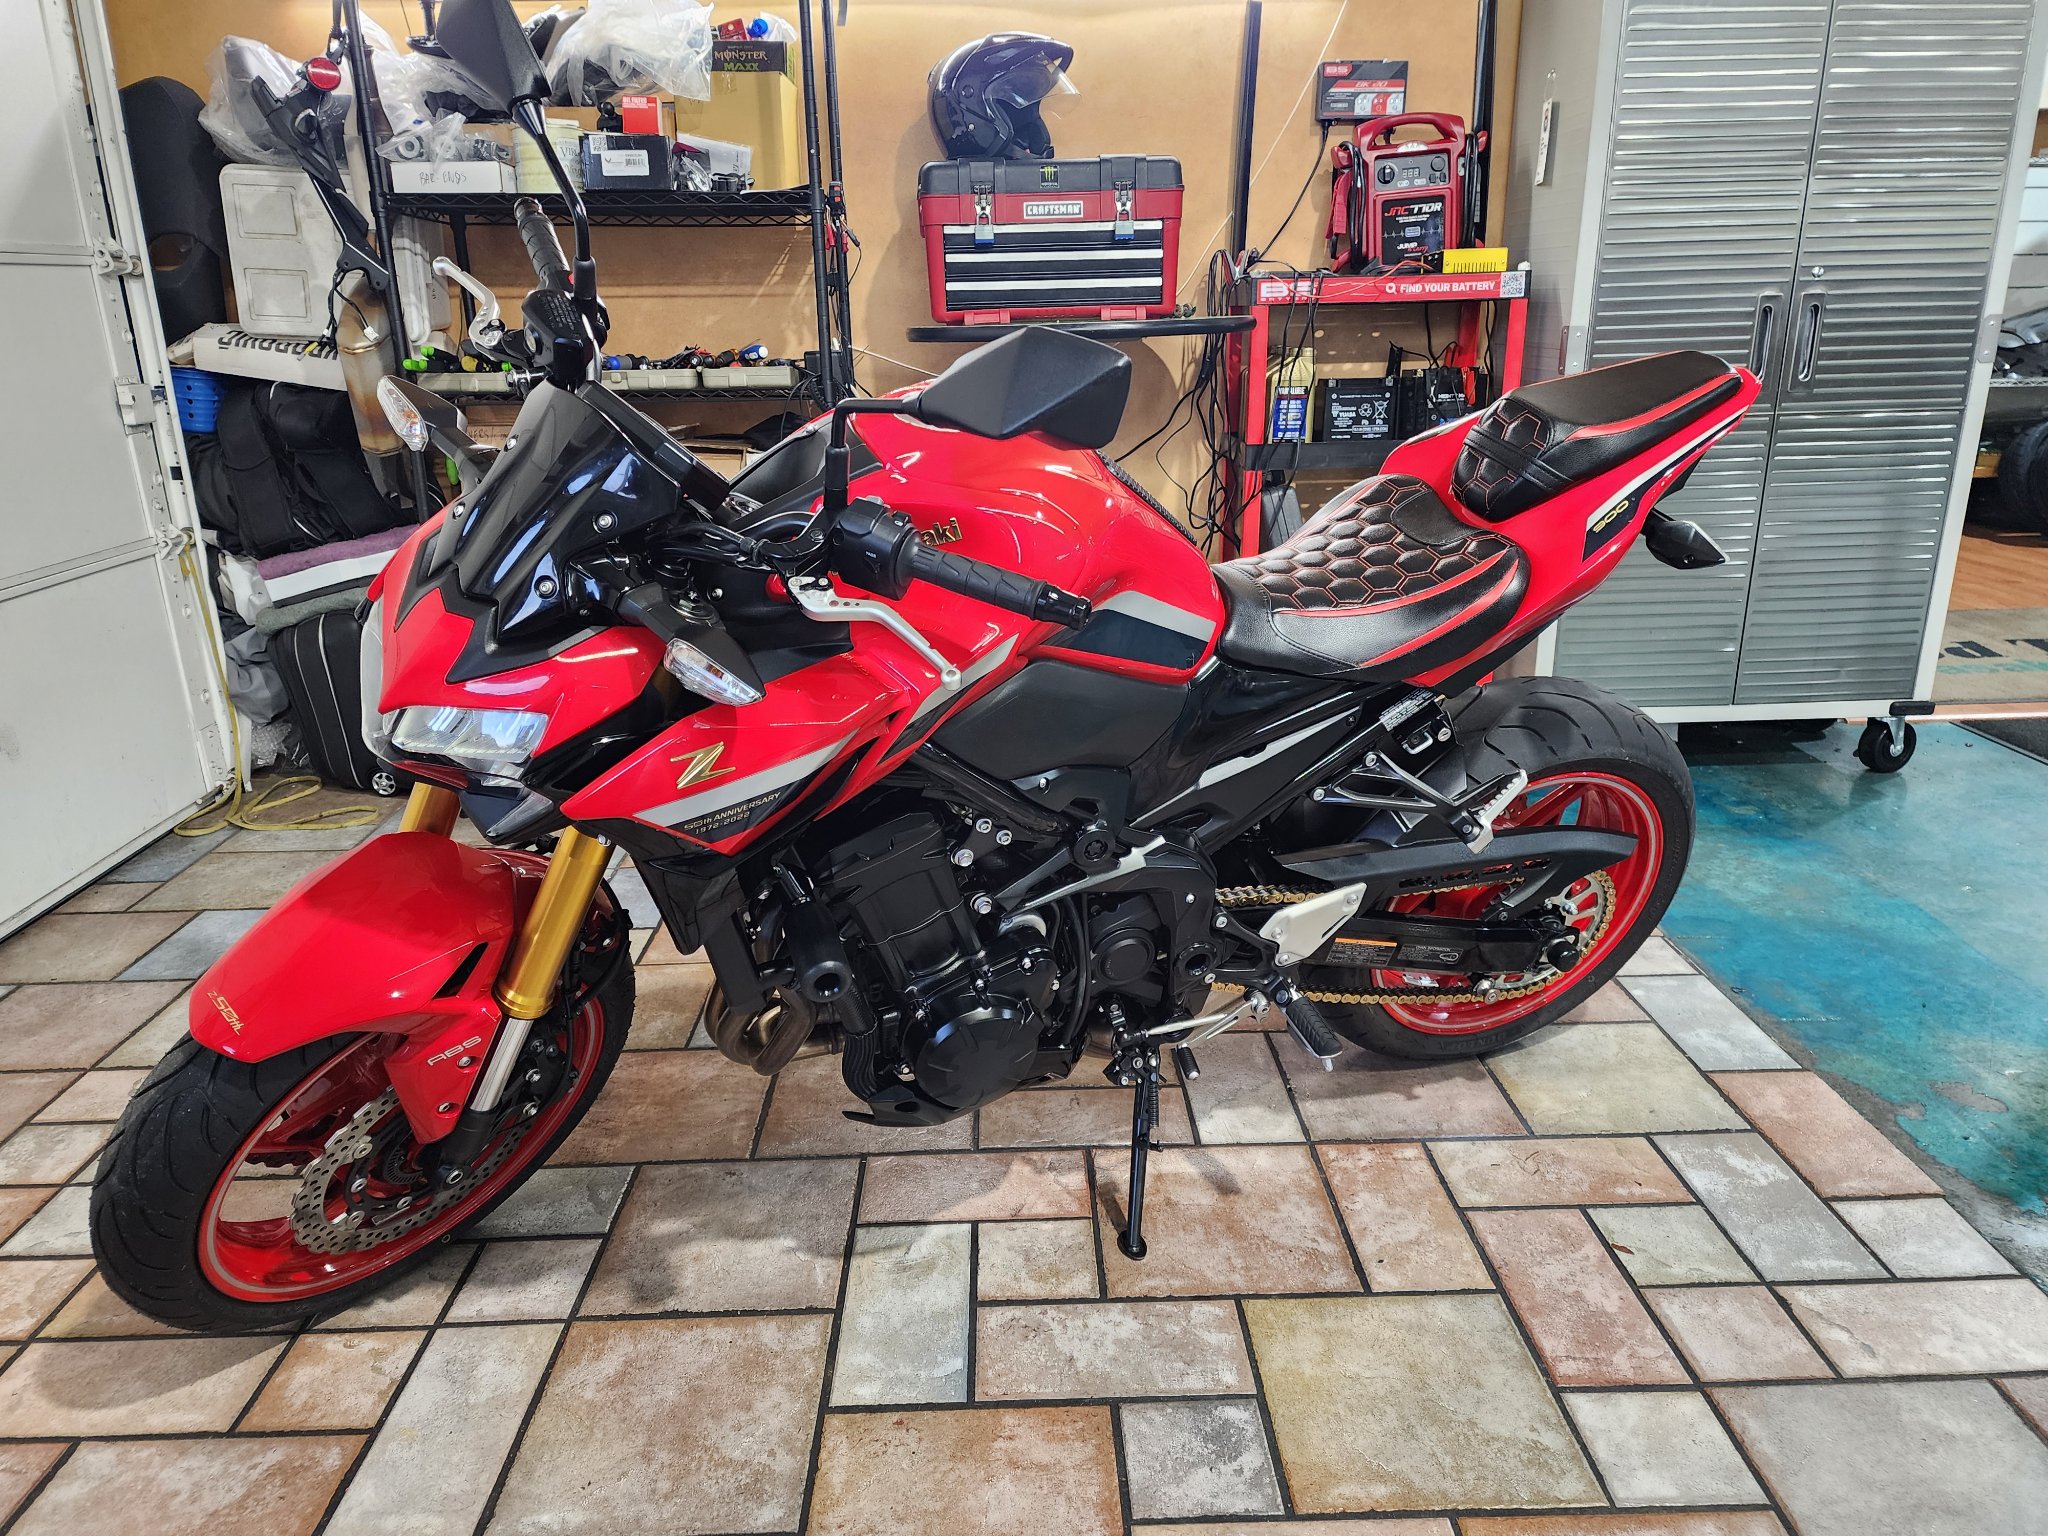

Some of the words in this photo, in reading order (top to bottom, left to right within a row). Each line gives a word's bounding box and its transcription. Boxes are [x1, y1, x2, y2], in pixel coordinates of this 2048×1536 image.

[713, 49, 768, 62] MONSTER
[723, 62, 759, 71] MAXX
[1326, 65, 1348, 73] BS
[1027, 204, 1081, 215] CRAFTSMAN
[1399, 283, 1422, 294] FIND
[1424, 282, 1450, 293] YOUR
[1452, 281, 1495, 292] BATTERY
[1592, 500, 1629, 534] 900
[920, 517, 963, 547] aki
[669, 740, 737, 790] Z
[713, 791, 781, 821] ANNIVERSARY
[427, 1035, 482, 1066] ABS
